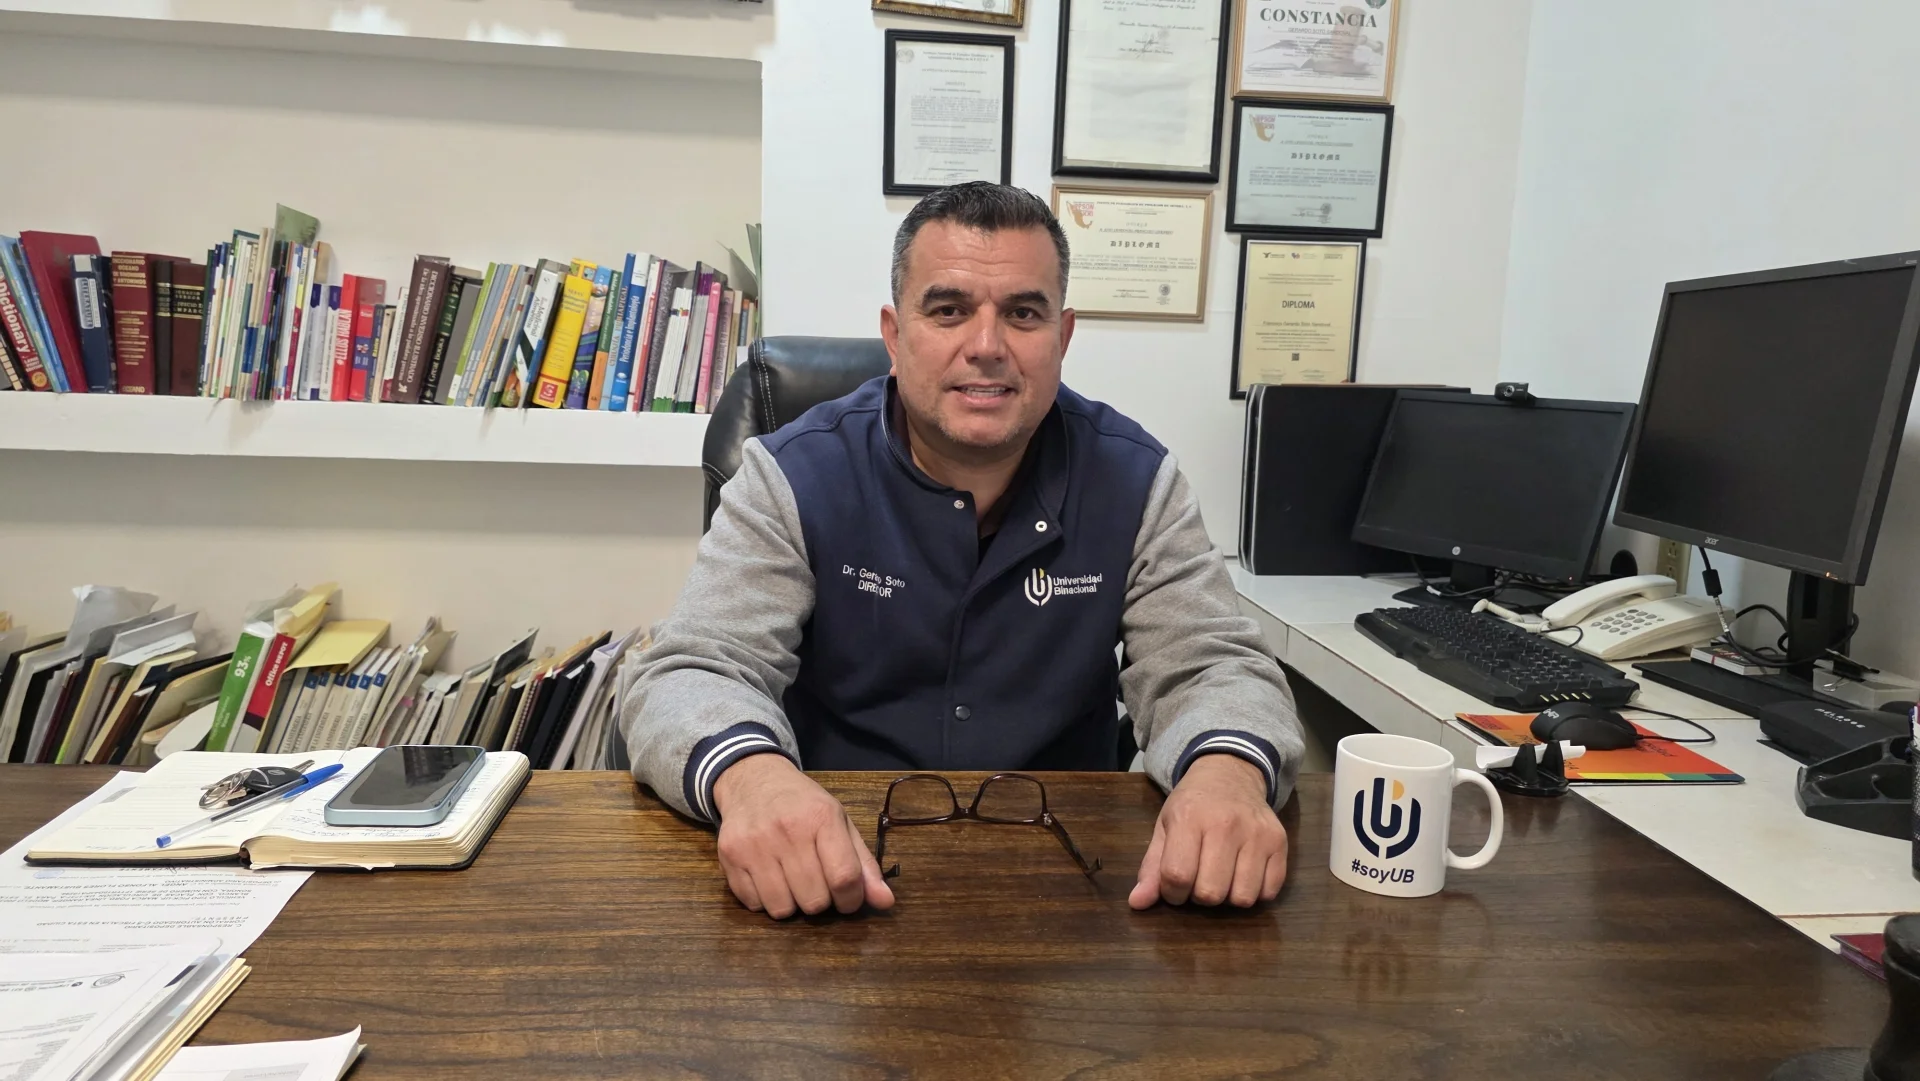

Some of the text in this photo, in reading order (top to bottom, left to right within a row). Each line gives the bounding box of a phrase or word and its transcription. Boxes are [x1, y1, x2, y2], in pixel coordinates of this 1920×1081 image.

[1260, 7, 1377, 28] CONSTANCIA
[1290, 152, 1341, 161] DIPLOMA
[1110, 240, 1160, 249] DIPLOMA
[1282, 300, 1315, 309] DIPLOMA
[0, 279, 31, 354] Dictionary
[406, 270, 438, 383] DICCIONARIO INVERSO ILUSTRADO
[619, 333, 633, 363] Periodoncia
[428, 361, 439, 382] Great
[1704, 536, 1719, 545] acer
[842, 564, 905, 588] Dr. Gero Soto
[1053, 573, 1103, 587] Universidad
[857, 579, 892, 598] DIREOR
[1053, 583, 1097, 596] Binacional
[233, 655, 252, 679] 93%
[265, 641, 289, 687] Office DEPOT
[1351, 858, 1415, 884] #soyUB
